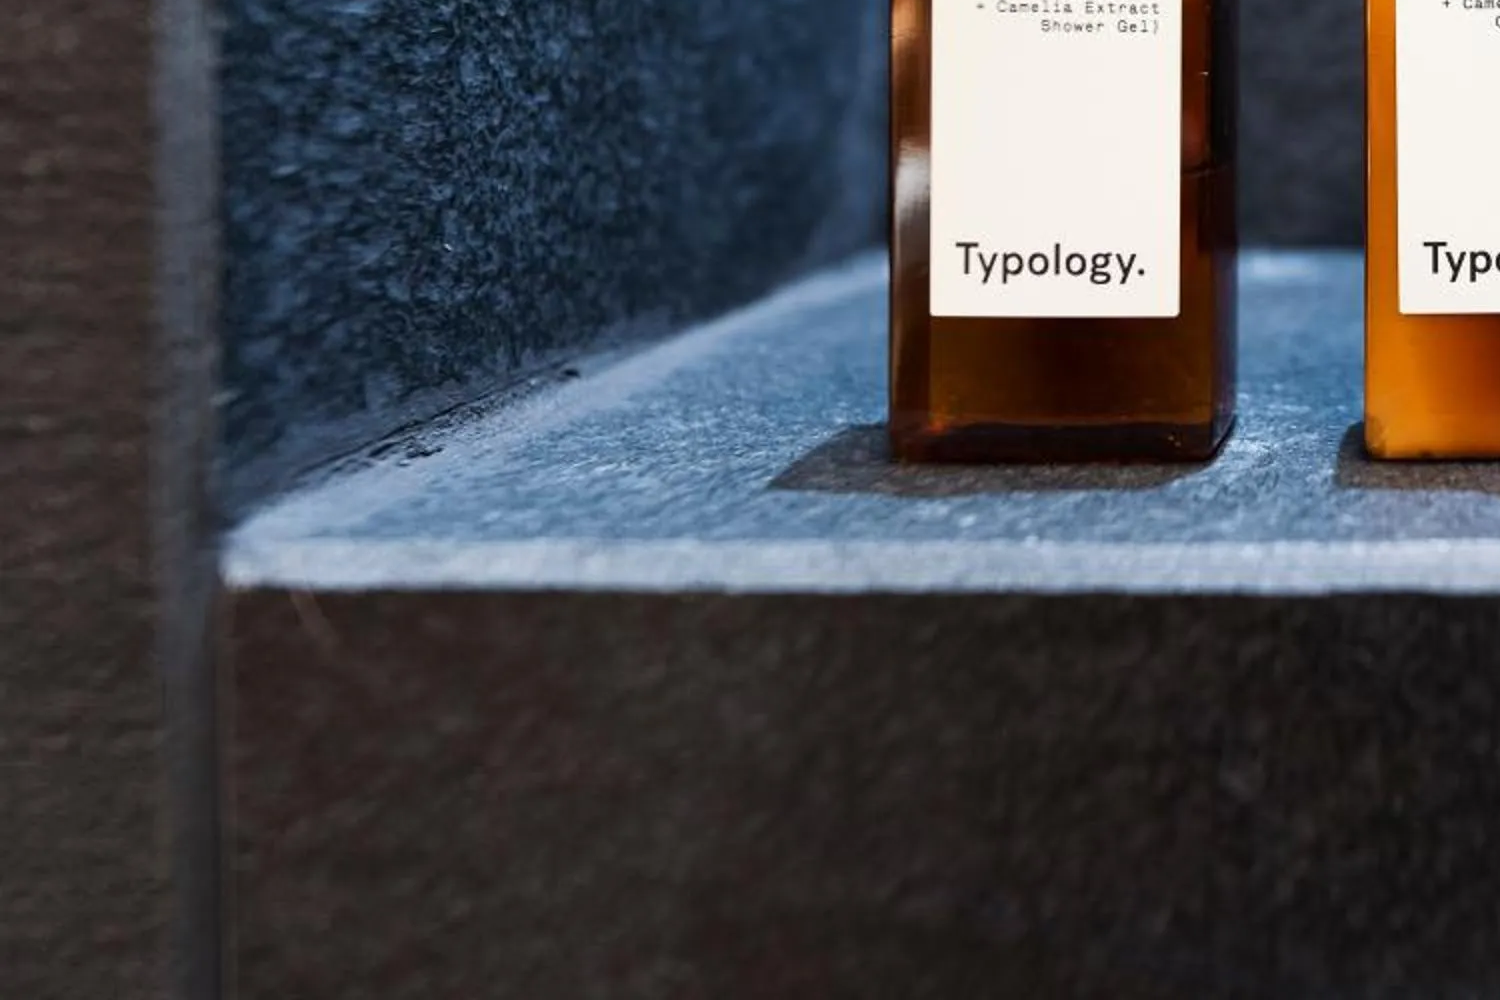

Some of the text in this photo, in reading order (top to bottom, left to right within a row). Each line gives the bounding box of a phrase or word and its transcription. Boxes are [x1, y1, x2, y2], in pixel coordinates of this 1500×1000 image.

[996, 0, 1073, 14] Camelia
[1084, 0, 1160, 16] Extract
[1040, 19, 1159, 35] Shower Gel)
[954, 241, 1145, 286] Typology.
